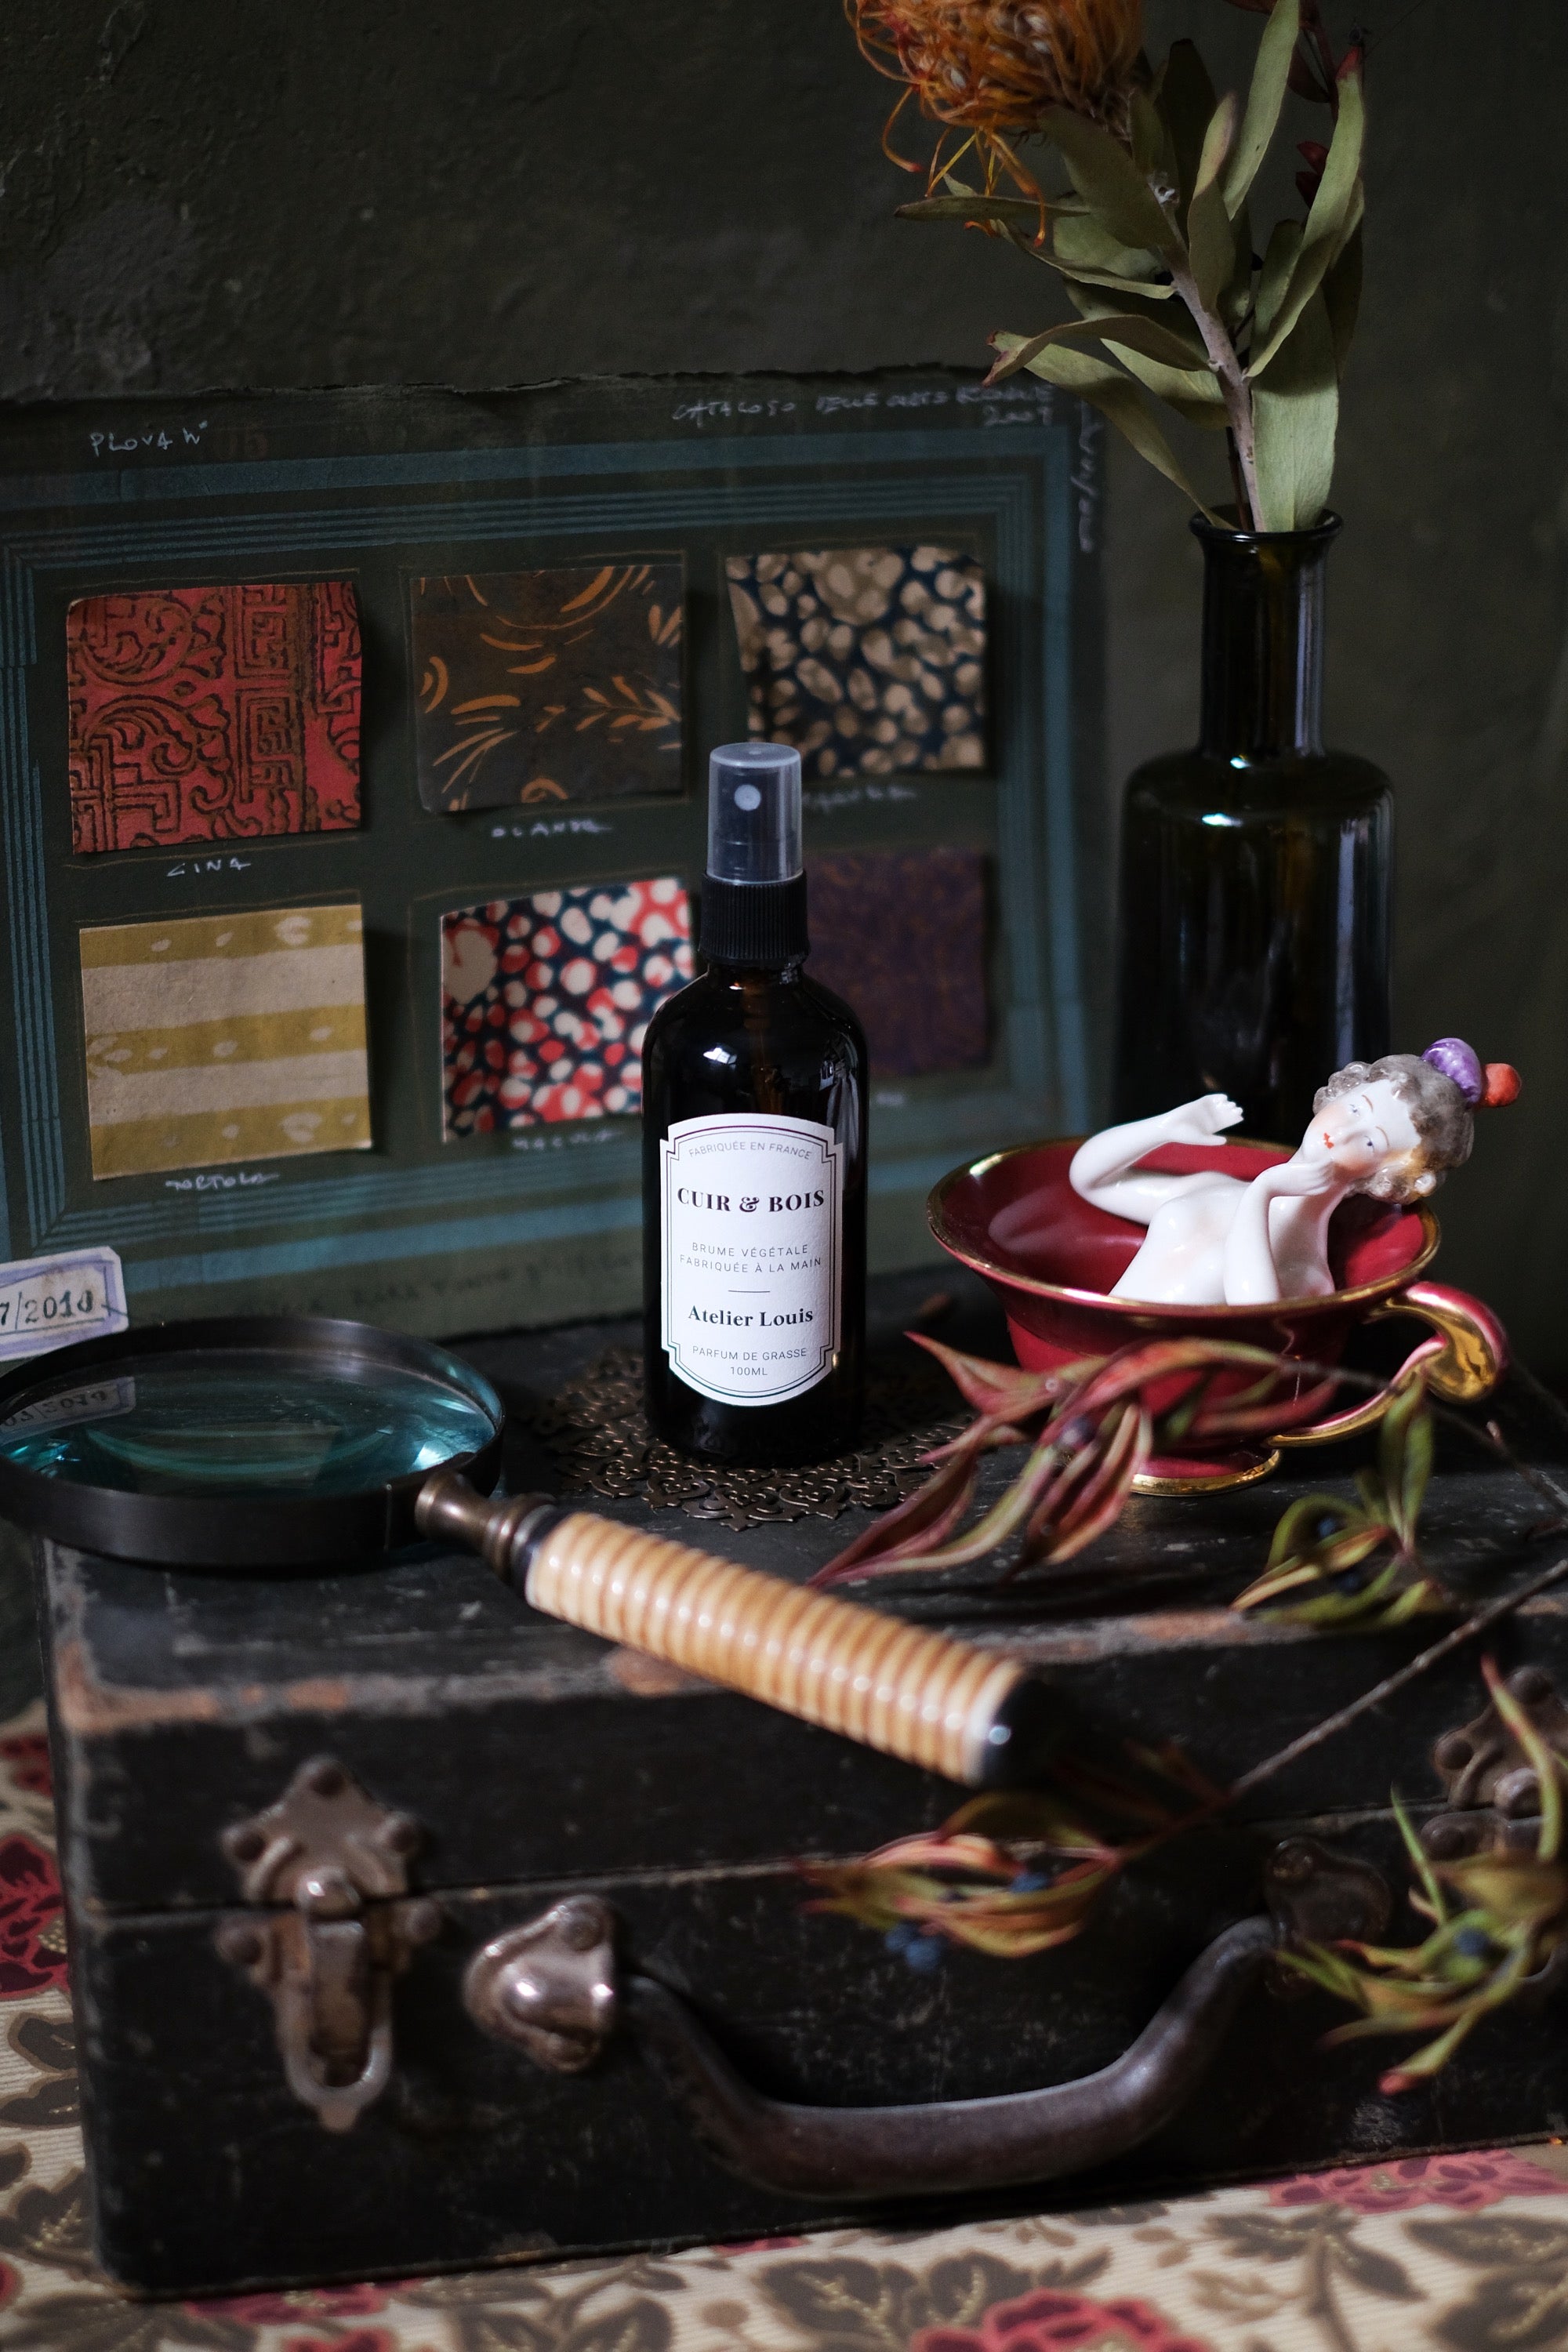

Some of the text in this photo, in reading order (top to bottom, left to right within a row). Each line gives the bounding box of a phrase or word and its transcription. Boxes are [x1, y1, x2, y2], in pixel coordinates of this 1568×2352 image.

[688, 1141, 812, 1160] FABRIQUÉE EN FRANCE
[677, 1188, 824, 1213] CUIR & BOIS
[692, 1242, 808, 1258] BRUME VÉGÉTALE
[680, 1254, 821, 1272] FABRIQUÉE À LA MAIN
[688, 1305, 813, 1327] Atelier Louis
[692, 1345, 808, 1360] PARFUM DE GRASSE
[731, 1367, 768, 1376] 100ML
